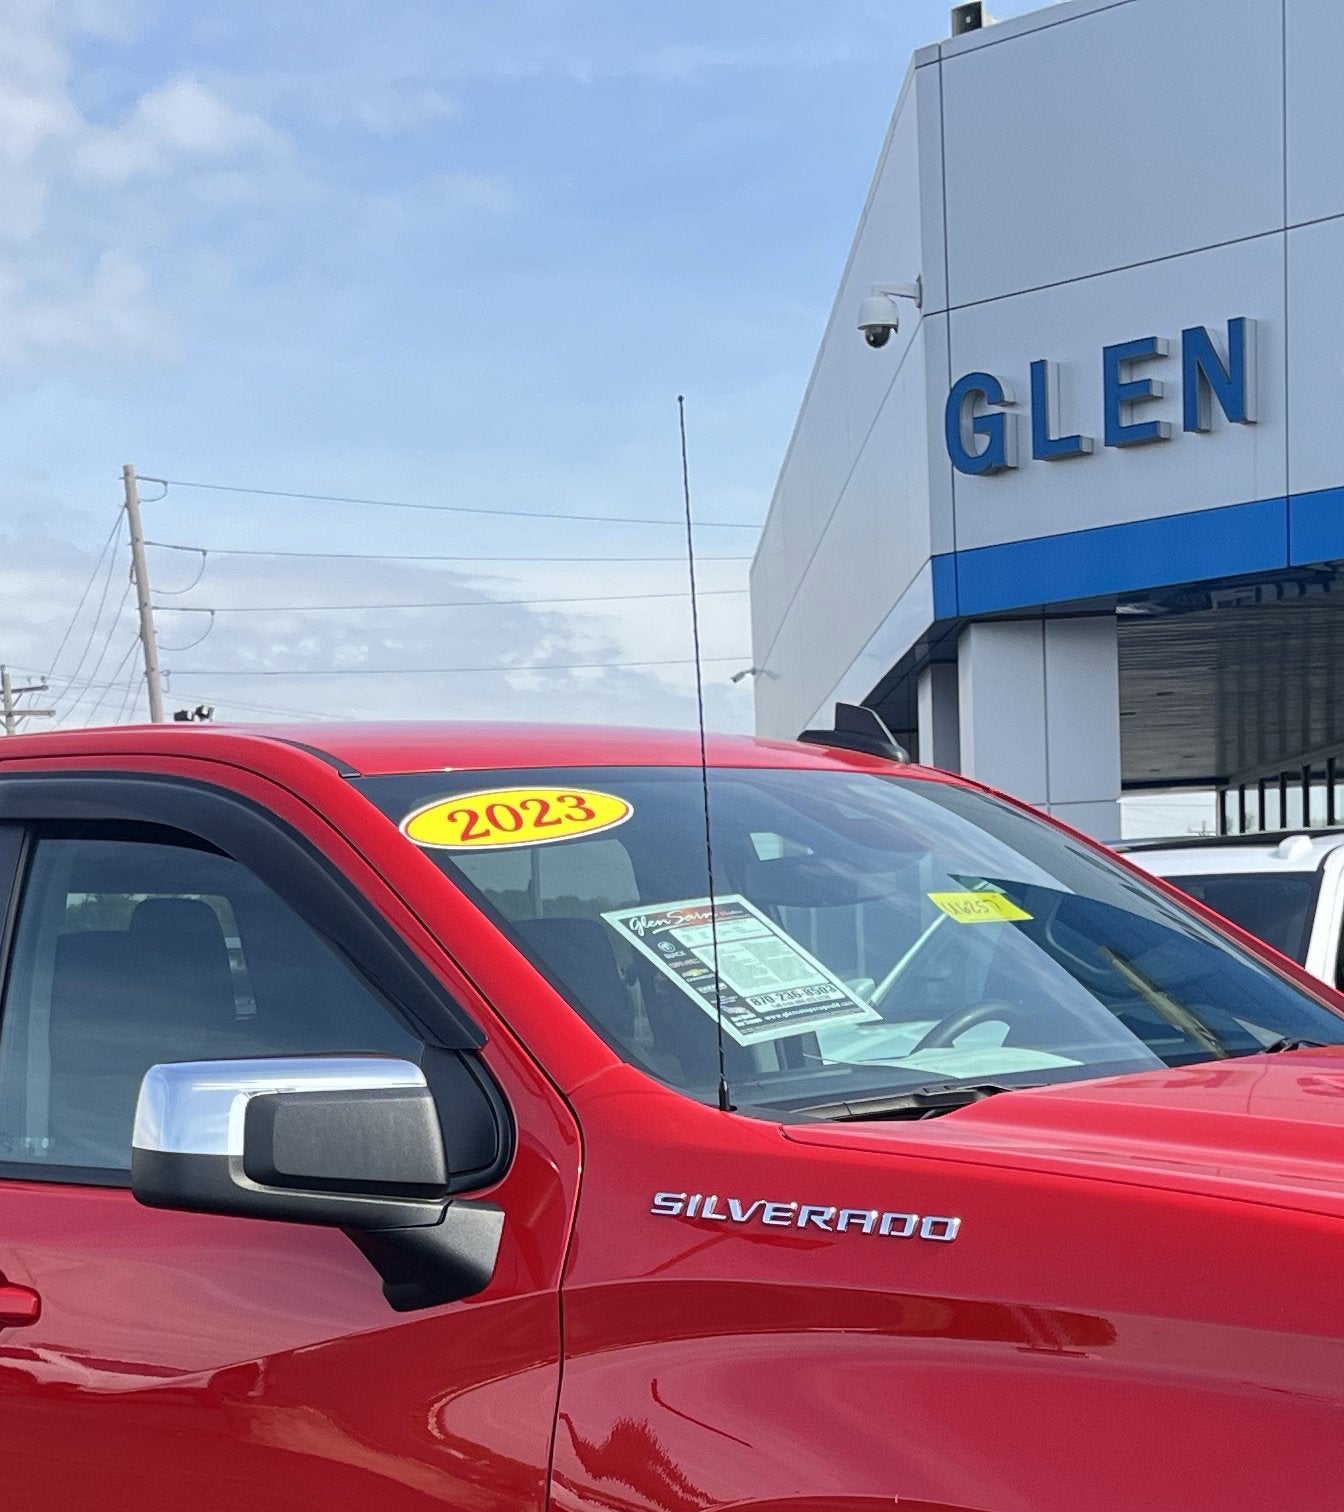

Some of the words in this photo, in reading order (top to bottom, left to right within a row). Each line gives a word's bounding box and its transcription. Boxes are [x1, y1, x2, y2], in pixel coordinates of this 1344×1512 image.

[946, 317, 1258, 476] GLEN
[447, 795, 596, 842] 2023
[650, 1191, 961, 1242] SILVERADO
